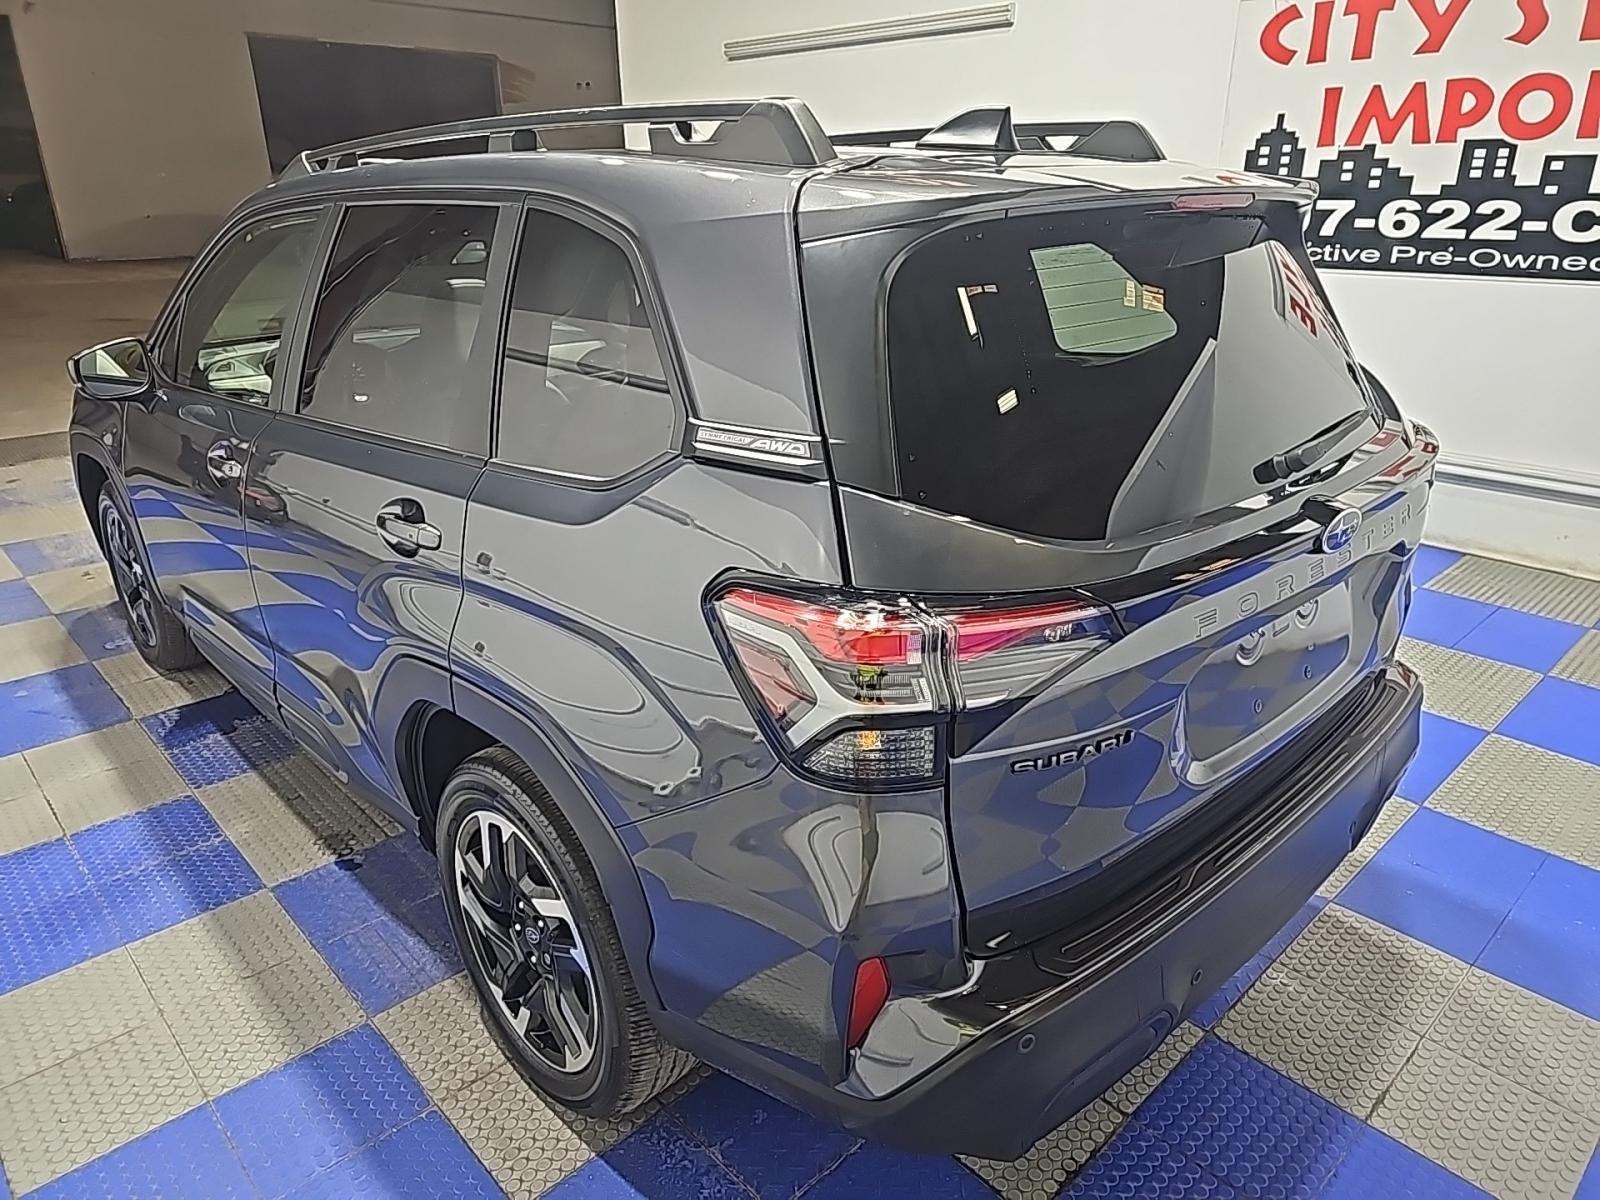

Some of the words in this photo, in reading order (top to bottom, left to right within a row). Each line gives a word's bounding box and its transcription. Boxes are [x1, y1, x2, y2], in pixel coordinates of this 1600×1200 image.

[1259, 0, 1472, 66] CITY
[1303, 199, 1600, 243] 7-622-C
[1306, 241, 1380, 263] ctive
[749, 438, 806, 456] AWD
[1193, 503, 1412, 640] FORESTER
[1010, 729, 1136, 776] SUBARU
